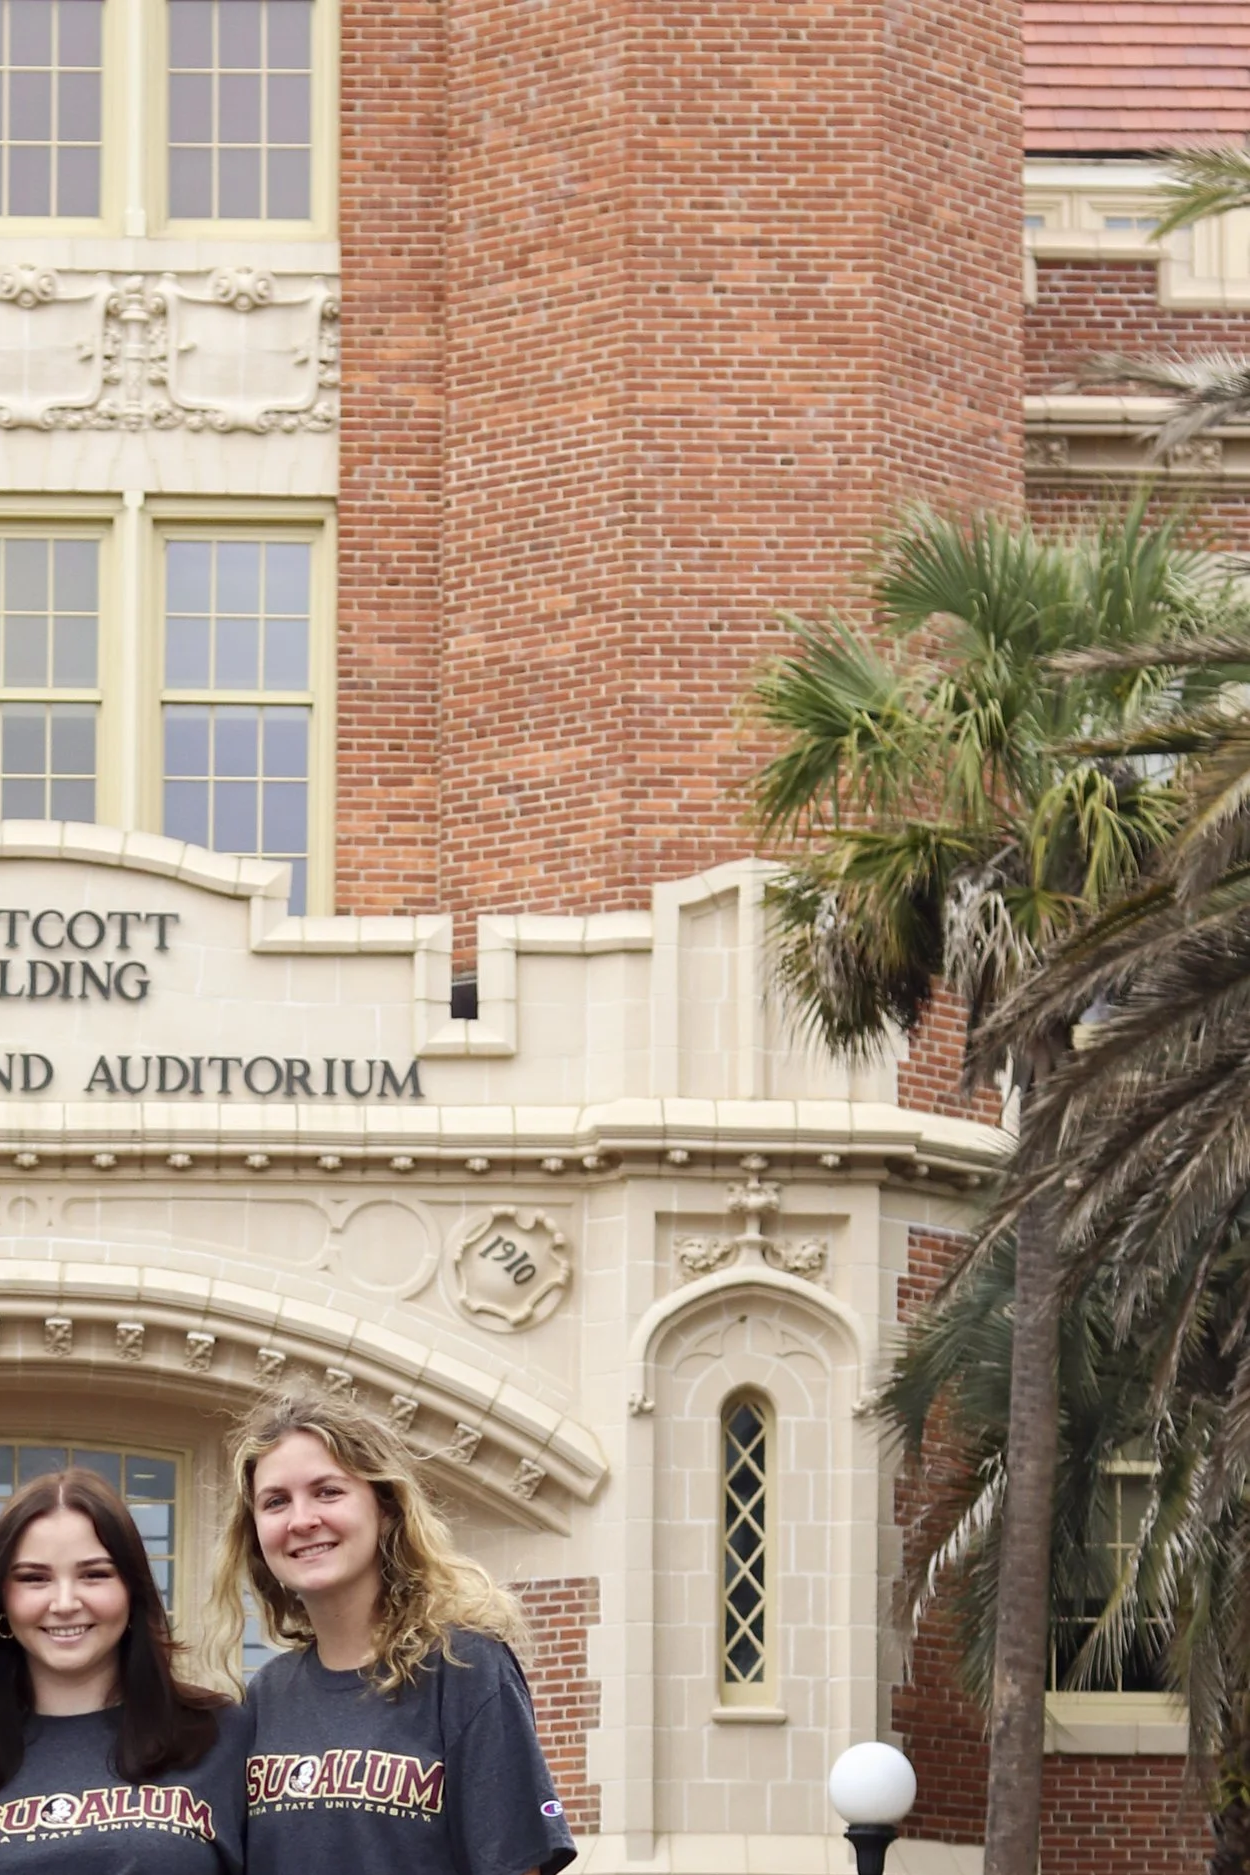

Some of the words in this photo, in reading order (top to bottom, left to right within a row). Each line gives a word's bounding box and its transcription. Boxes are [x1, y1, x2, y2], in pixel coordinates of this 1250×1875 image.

[84, 1055, 425, 1099] AUDITORIUM
[478, 1235, 536, 1286] 1910
[245, 1754, 300, 1806] SU
[307, 1749, 444, 1814] ALUM
[72, 1784, 216, 1840] ALUM
[275, 1802, 314, 1812] STATE
[325, 1801, 430, 1822] UNIVERSITY
[26, 1829, 83, 1842] STATE
